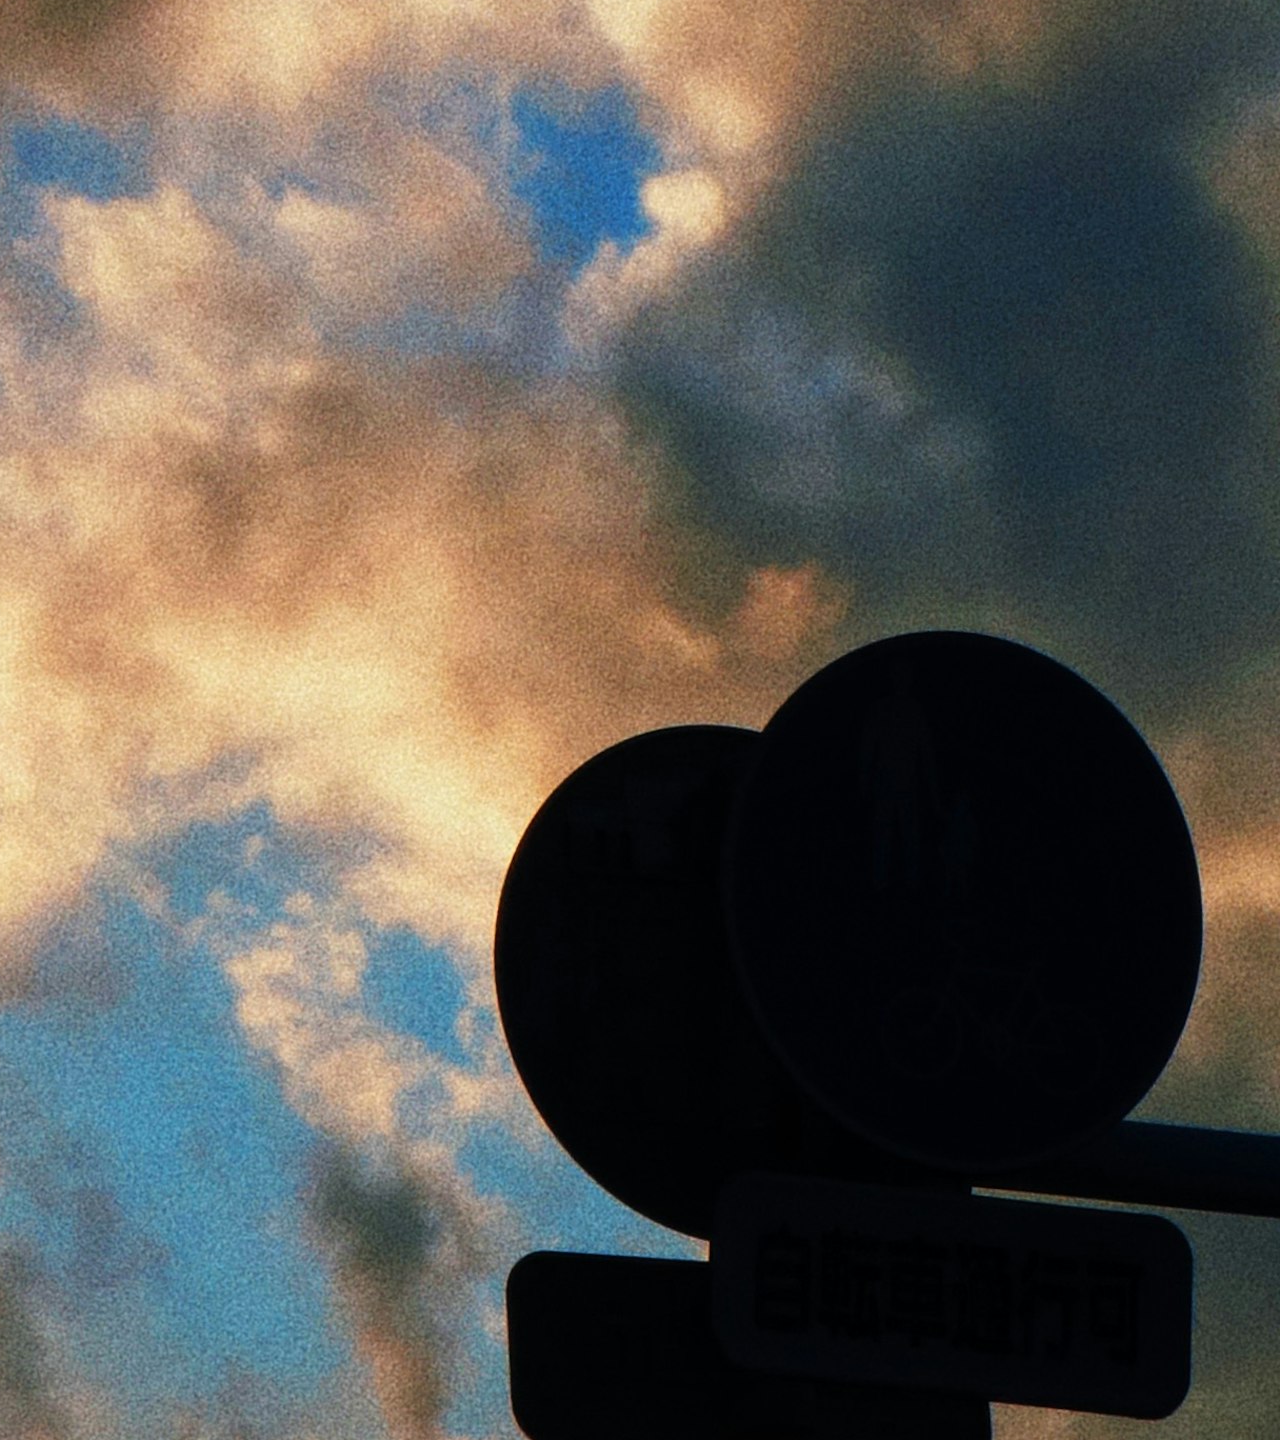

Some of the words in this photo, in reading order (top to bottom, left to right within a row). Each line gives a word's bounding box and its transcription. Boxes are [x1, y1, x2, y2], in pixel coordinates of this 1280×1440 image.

[751, 1219, 1146, 1373] 自転車通行可
